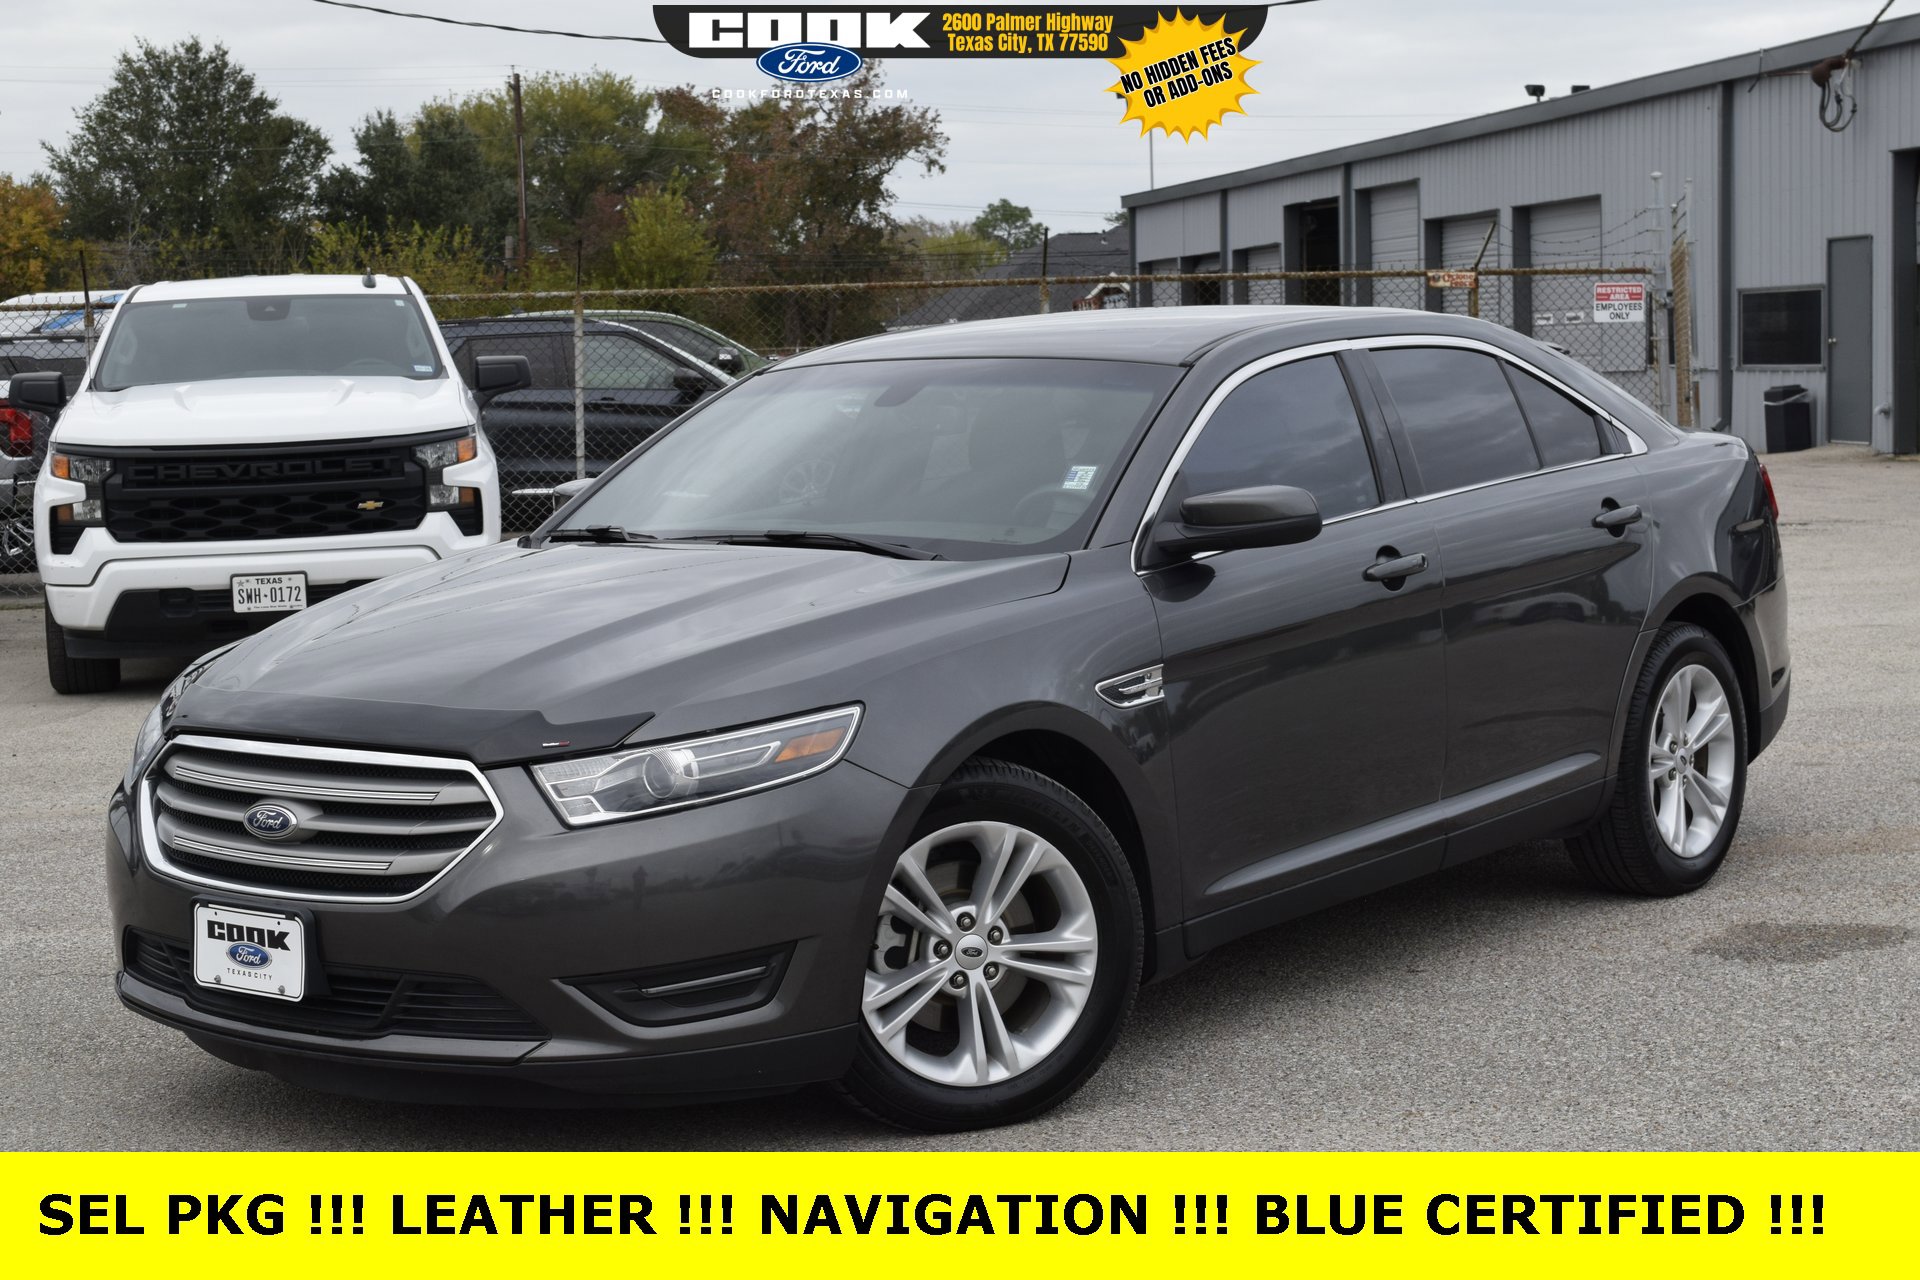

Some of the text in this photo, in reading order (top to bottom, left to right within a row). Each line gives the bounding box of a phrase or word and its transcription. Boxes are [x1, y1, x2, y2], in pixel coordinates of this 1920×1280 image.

[1596, 286, 1642, 294] RESTRICTED
[1595, 302, 1643, 312] EMPLOYEES
[1609, 311, 1631, 320] ONLY
[127, 455, 400, 481] CHEVROLET
[254, 577, 283, 585] TEXAS
[252, 809, 284, 830] Ford
[207, 919, 291, 952] COOK
[235, 945, 262, 965] Ford
